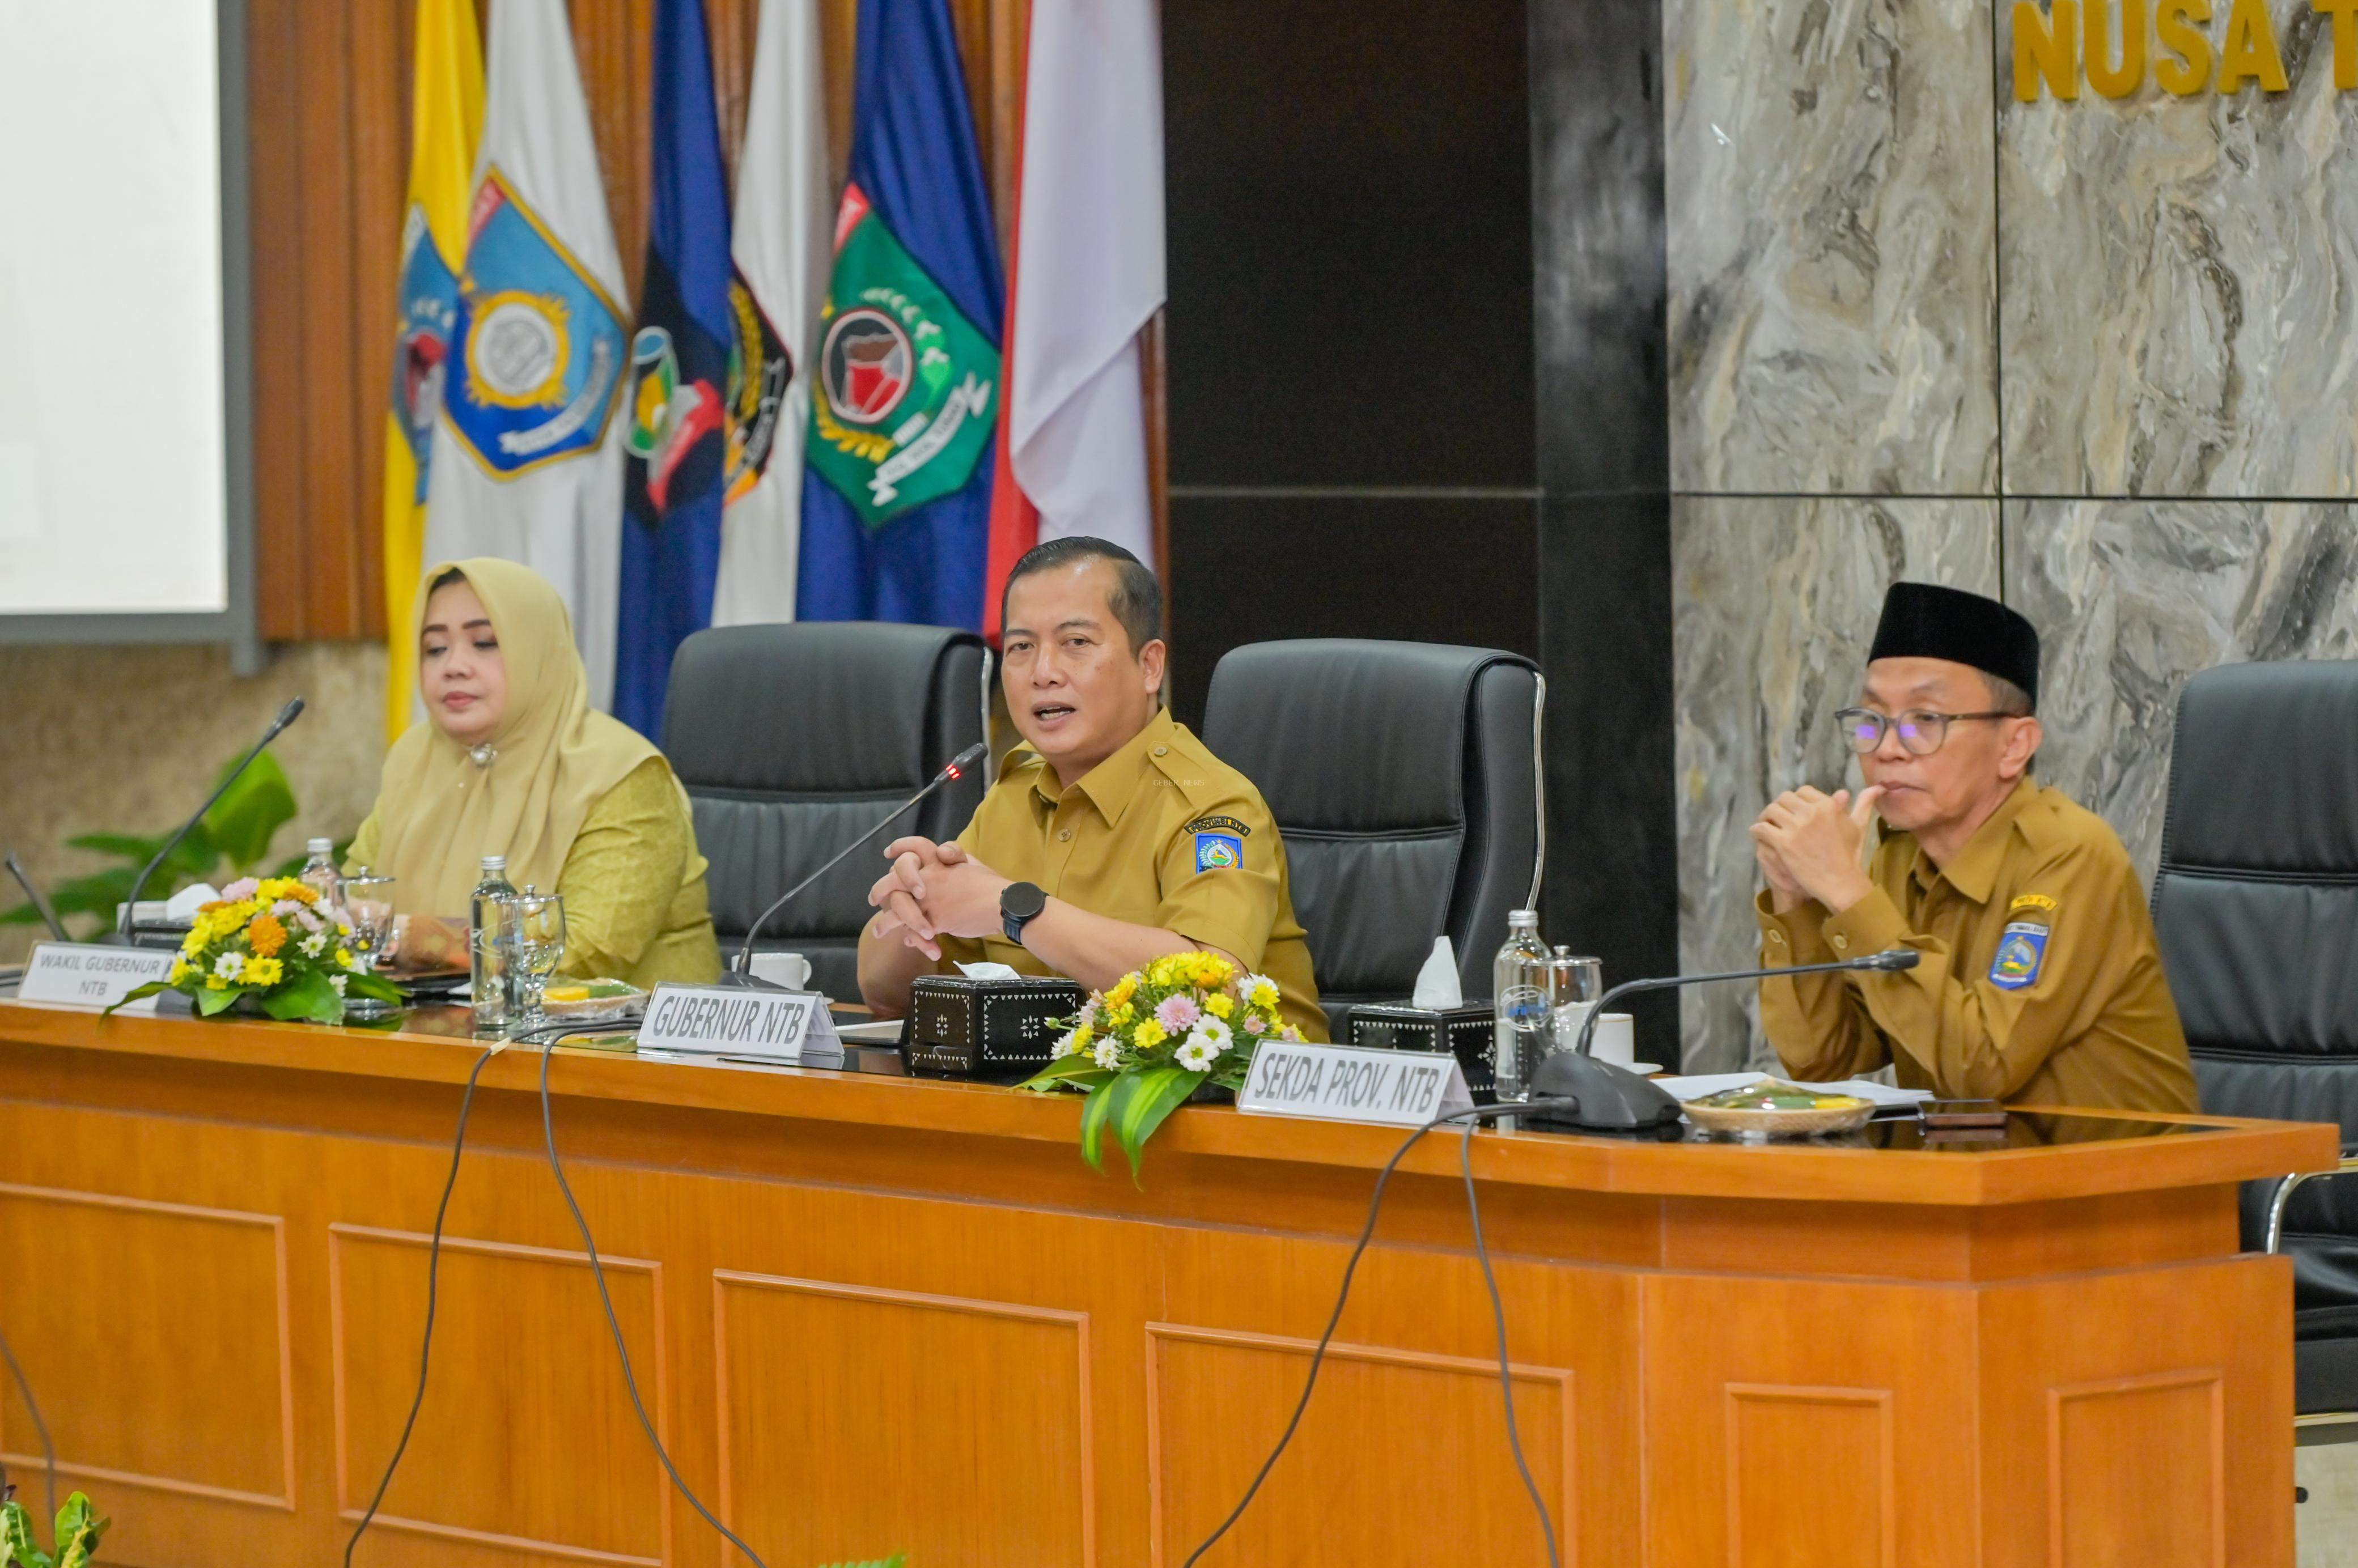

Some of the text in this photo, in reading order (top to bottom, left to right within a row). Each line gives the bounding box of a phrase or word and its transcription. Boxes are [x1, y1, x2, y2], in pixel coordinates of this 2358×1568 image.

[2012, 0, 2289, 101] NUSA
[41, 954, 159, 974] WAKIL GUBERNUR
[80, 981, 108, 995] NTB
[653, 996, 805, 1044] GUBERNUR NTB
[1254, 1053, 1440, 1112] SEKDA PROV. NTB
